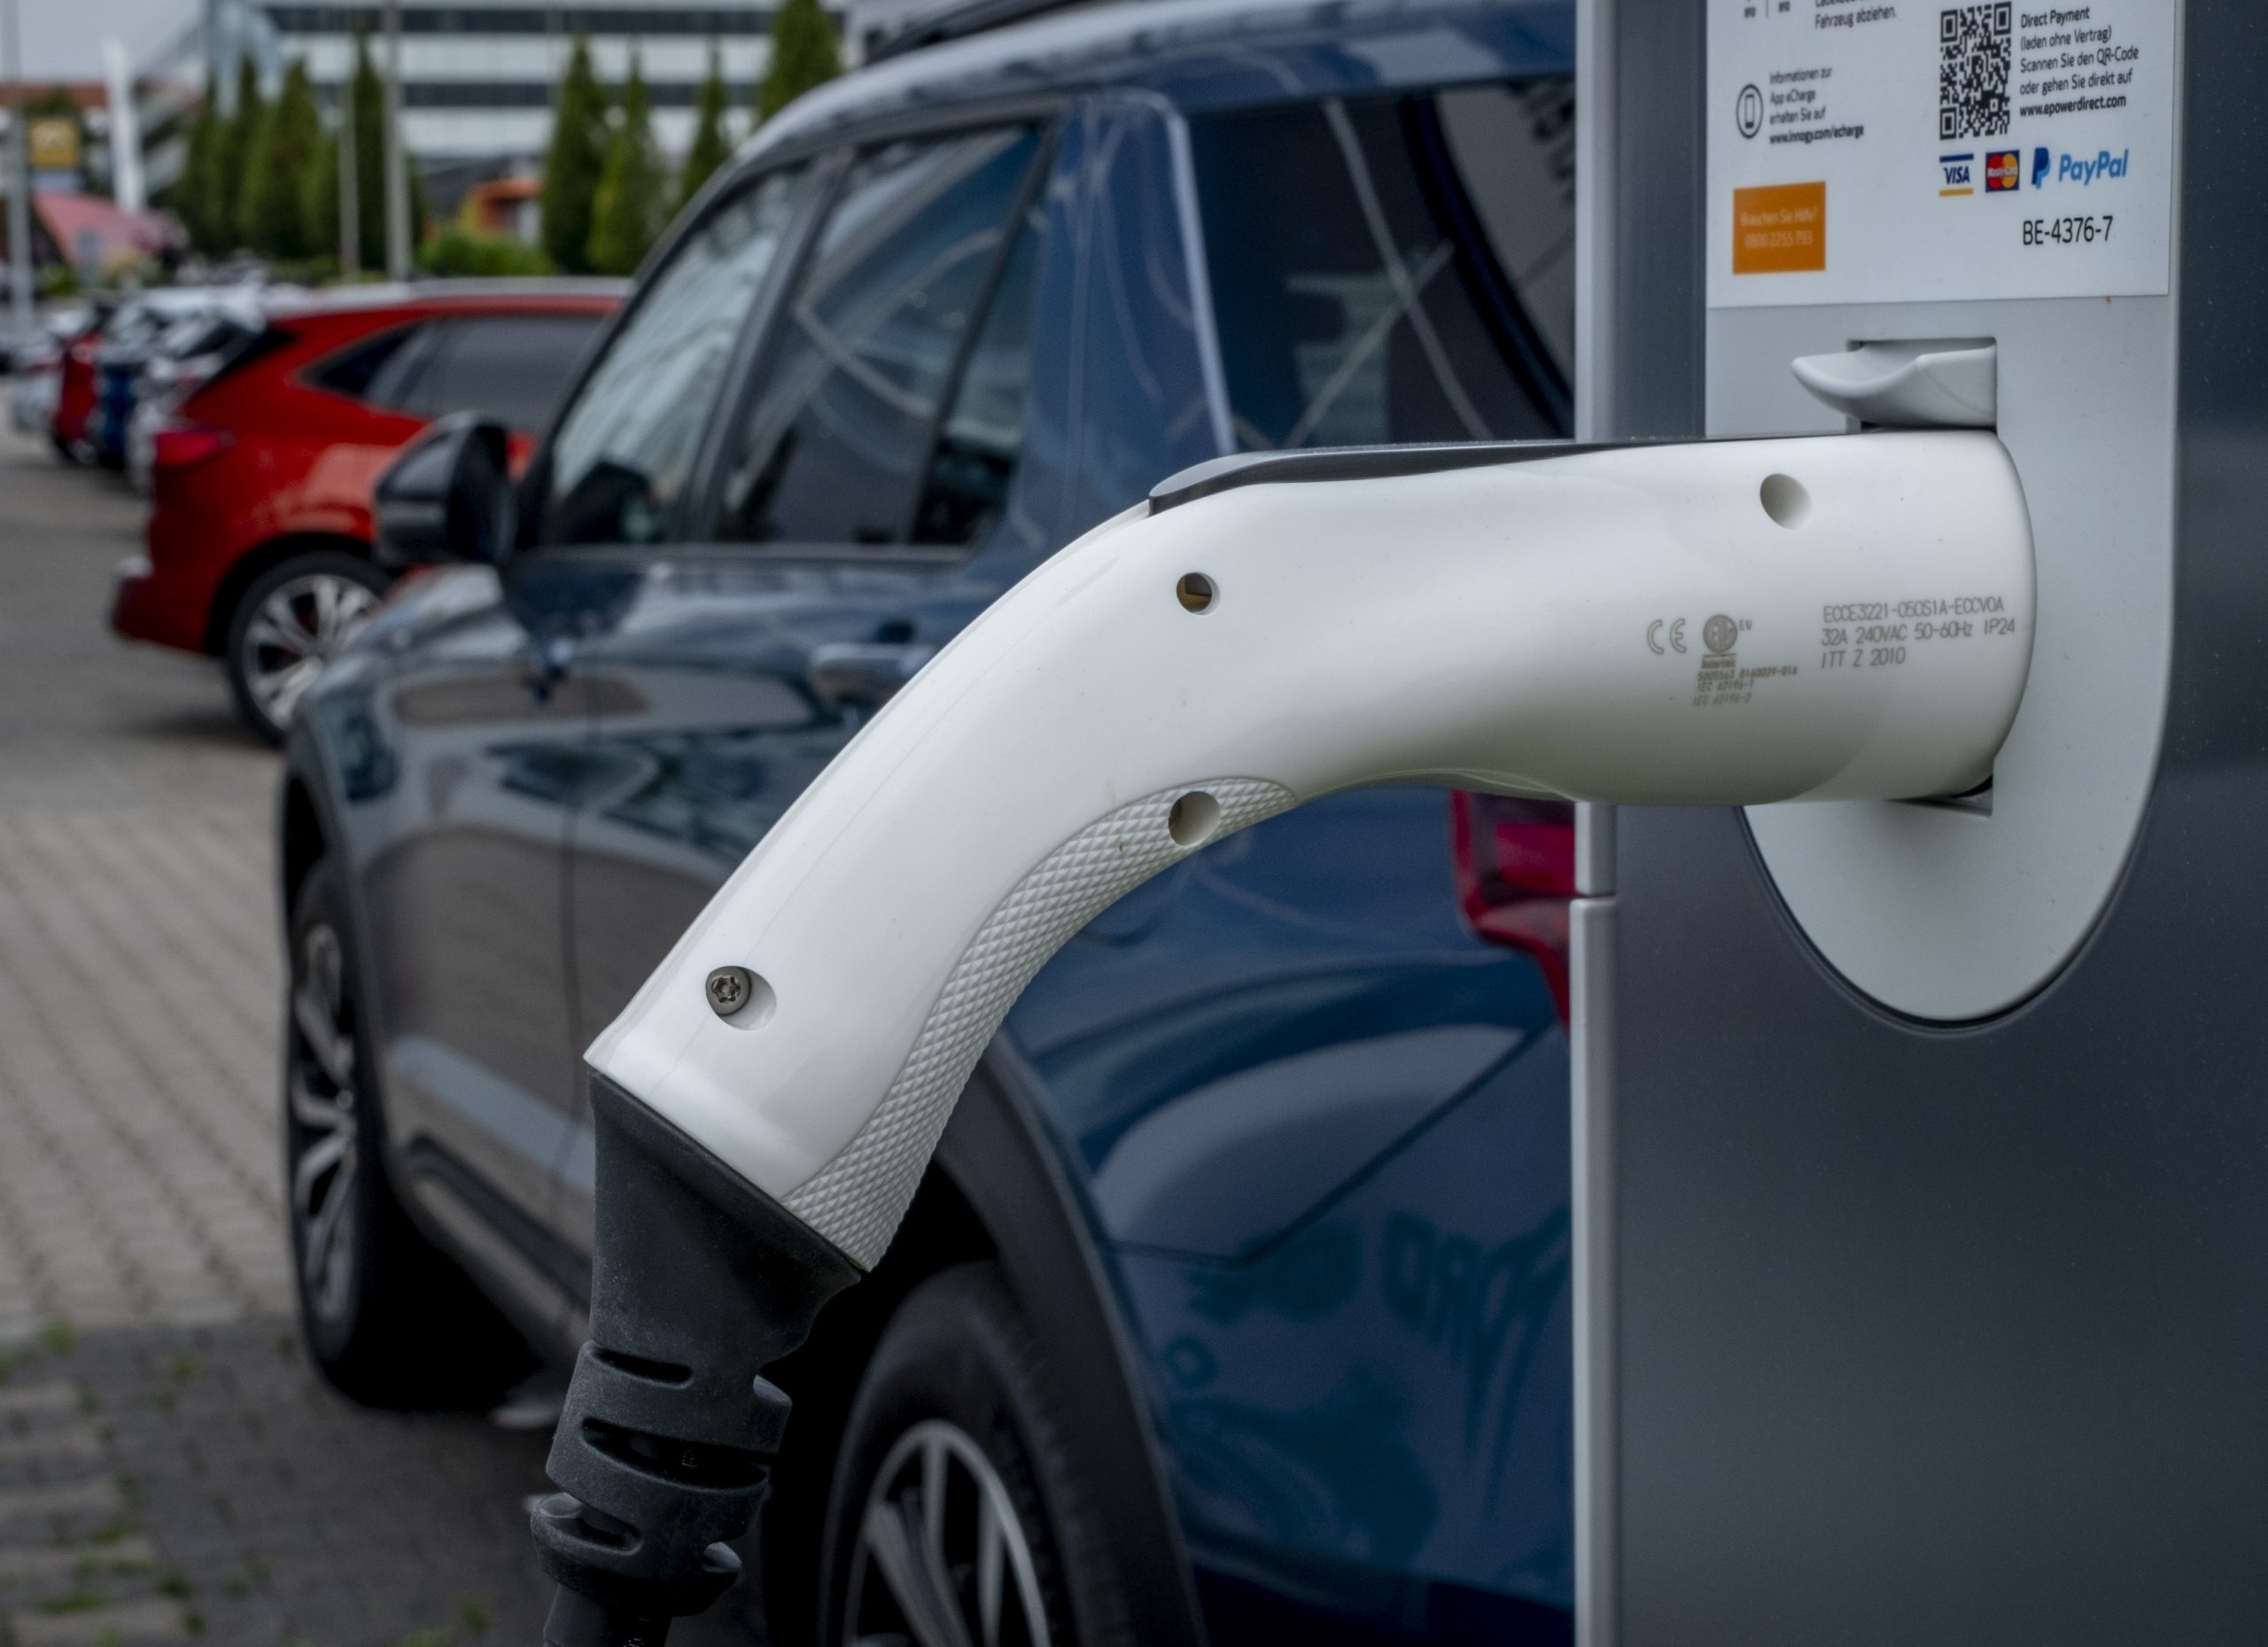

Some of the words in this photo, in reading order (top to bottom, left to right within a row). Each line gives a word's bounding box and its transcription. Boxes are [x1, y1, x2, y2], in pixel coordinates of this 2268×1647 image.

[1815, 13, 1853, 28] Fahrzeug
[2021, 12, 2047, 28] Direct
[2050, 7, 2090, 27] Payment
[2020, 35, 2047, 51] (laden
[2049, 32, 2071, 47] ohne
[2074, 24, 2112, 43] Vertrag)
[2020, 58, 2058, 74] Scannen
[2061, 52, 2075, 68] Sie
[2077, 50, 2094, 66] den
[2096, 44, 2140, 66] QR-Code
[2020, 79, 2039, 96] oder
[2041, 76, 2069, 97] gehen
[2071, 74, 2085, 89] Sie
[2087, 70, 2115, 88] direkt
[2117, 66, 2133, 84] auf
[2020, 95, 2126, 117] www.epowerdirect.com
[1943, 166, 1971, 185] VISA
[2058, 148, 2130, 187] PayPal
[2023, 215, 2114, 245] BE-4376-7
[1821, 627, 1848, 647] 32A
[1855, 623, 1907, 644] 240VAC
[1915, 621, 1974, 641] 50-60Hz
[1984, 617, 2016, 636] IP24
[1821, 649, 1846, 669] ITT
[1852, 649, 1864, 668] Z
[1868, 646, 1907, 666] 2010
